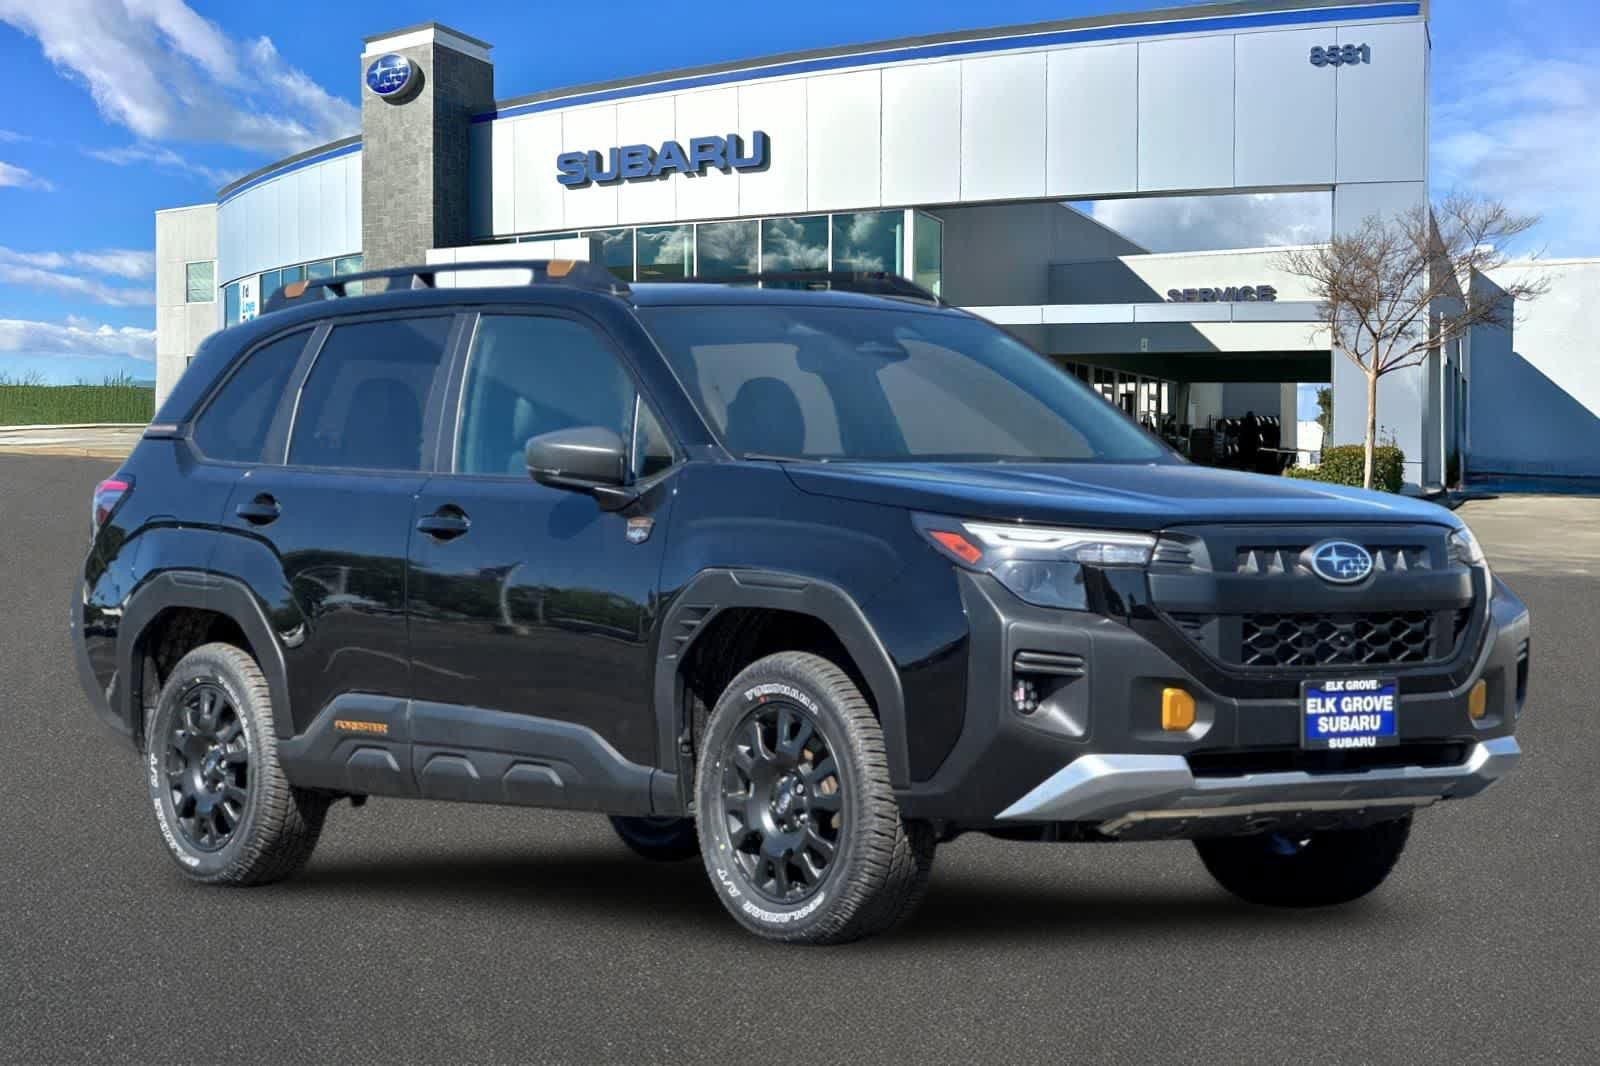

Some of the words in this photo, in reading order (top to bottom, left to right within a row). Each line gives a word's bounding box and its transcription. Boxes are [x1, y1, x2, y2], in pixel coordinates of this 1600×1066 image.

[556, 130, 771, 190] SUBARU
[1167, 284, 1277, 302] SERVICE
[1325, 681, 1344, 691] ELK
[1345, 680, 1377, 691] GROVE
[1306, 697, 1337, 714] ELK
[1341, 695, 1393, 713] GROVE
[1318, 715, 1381, 733] SUBARU
[1328, 736, 1376, 748] SUBARU
